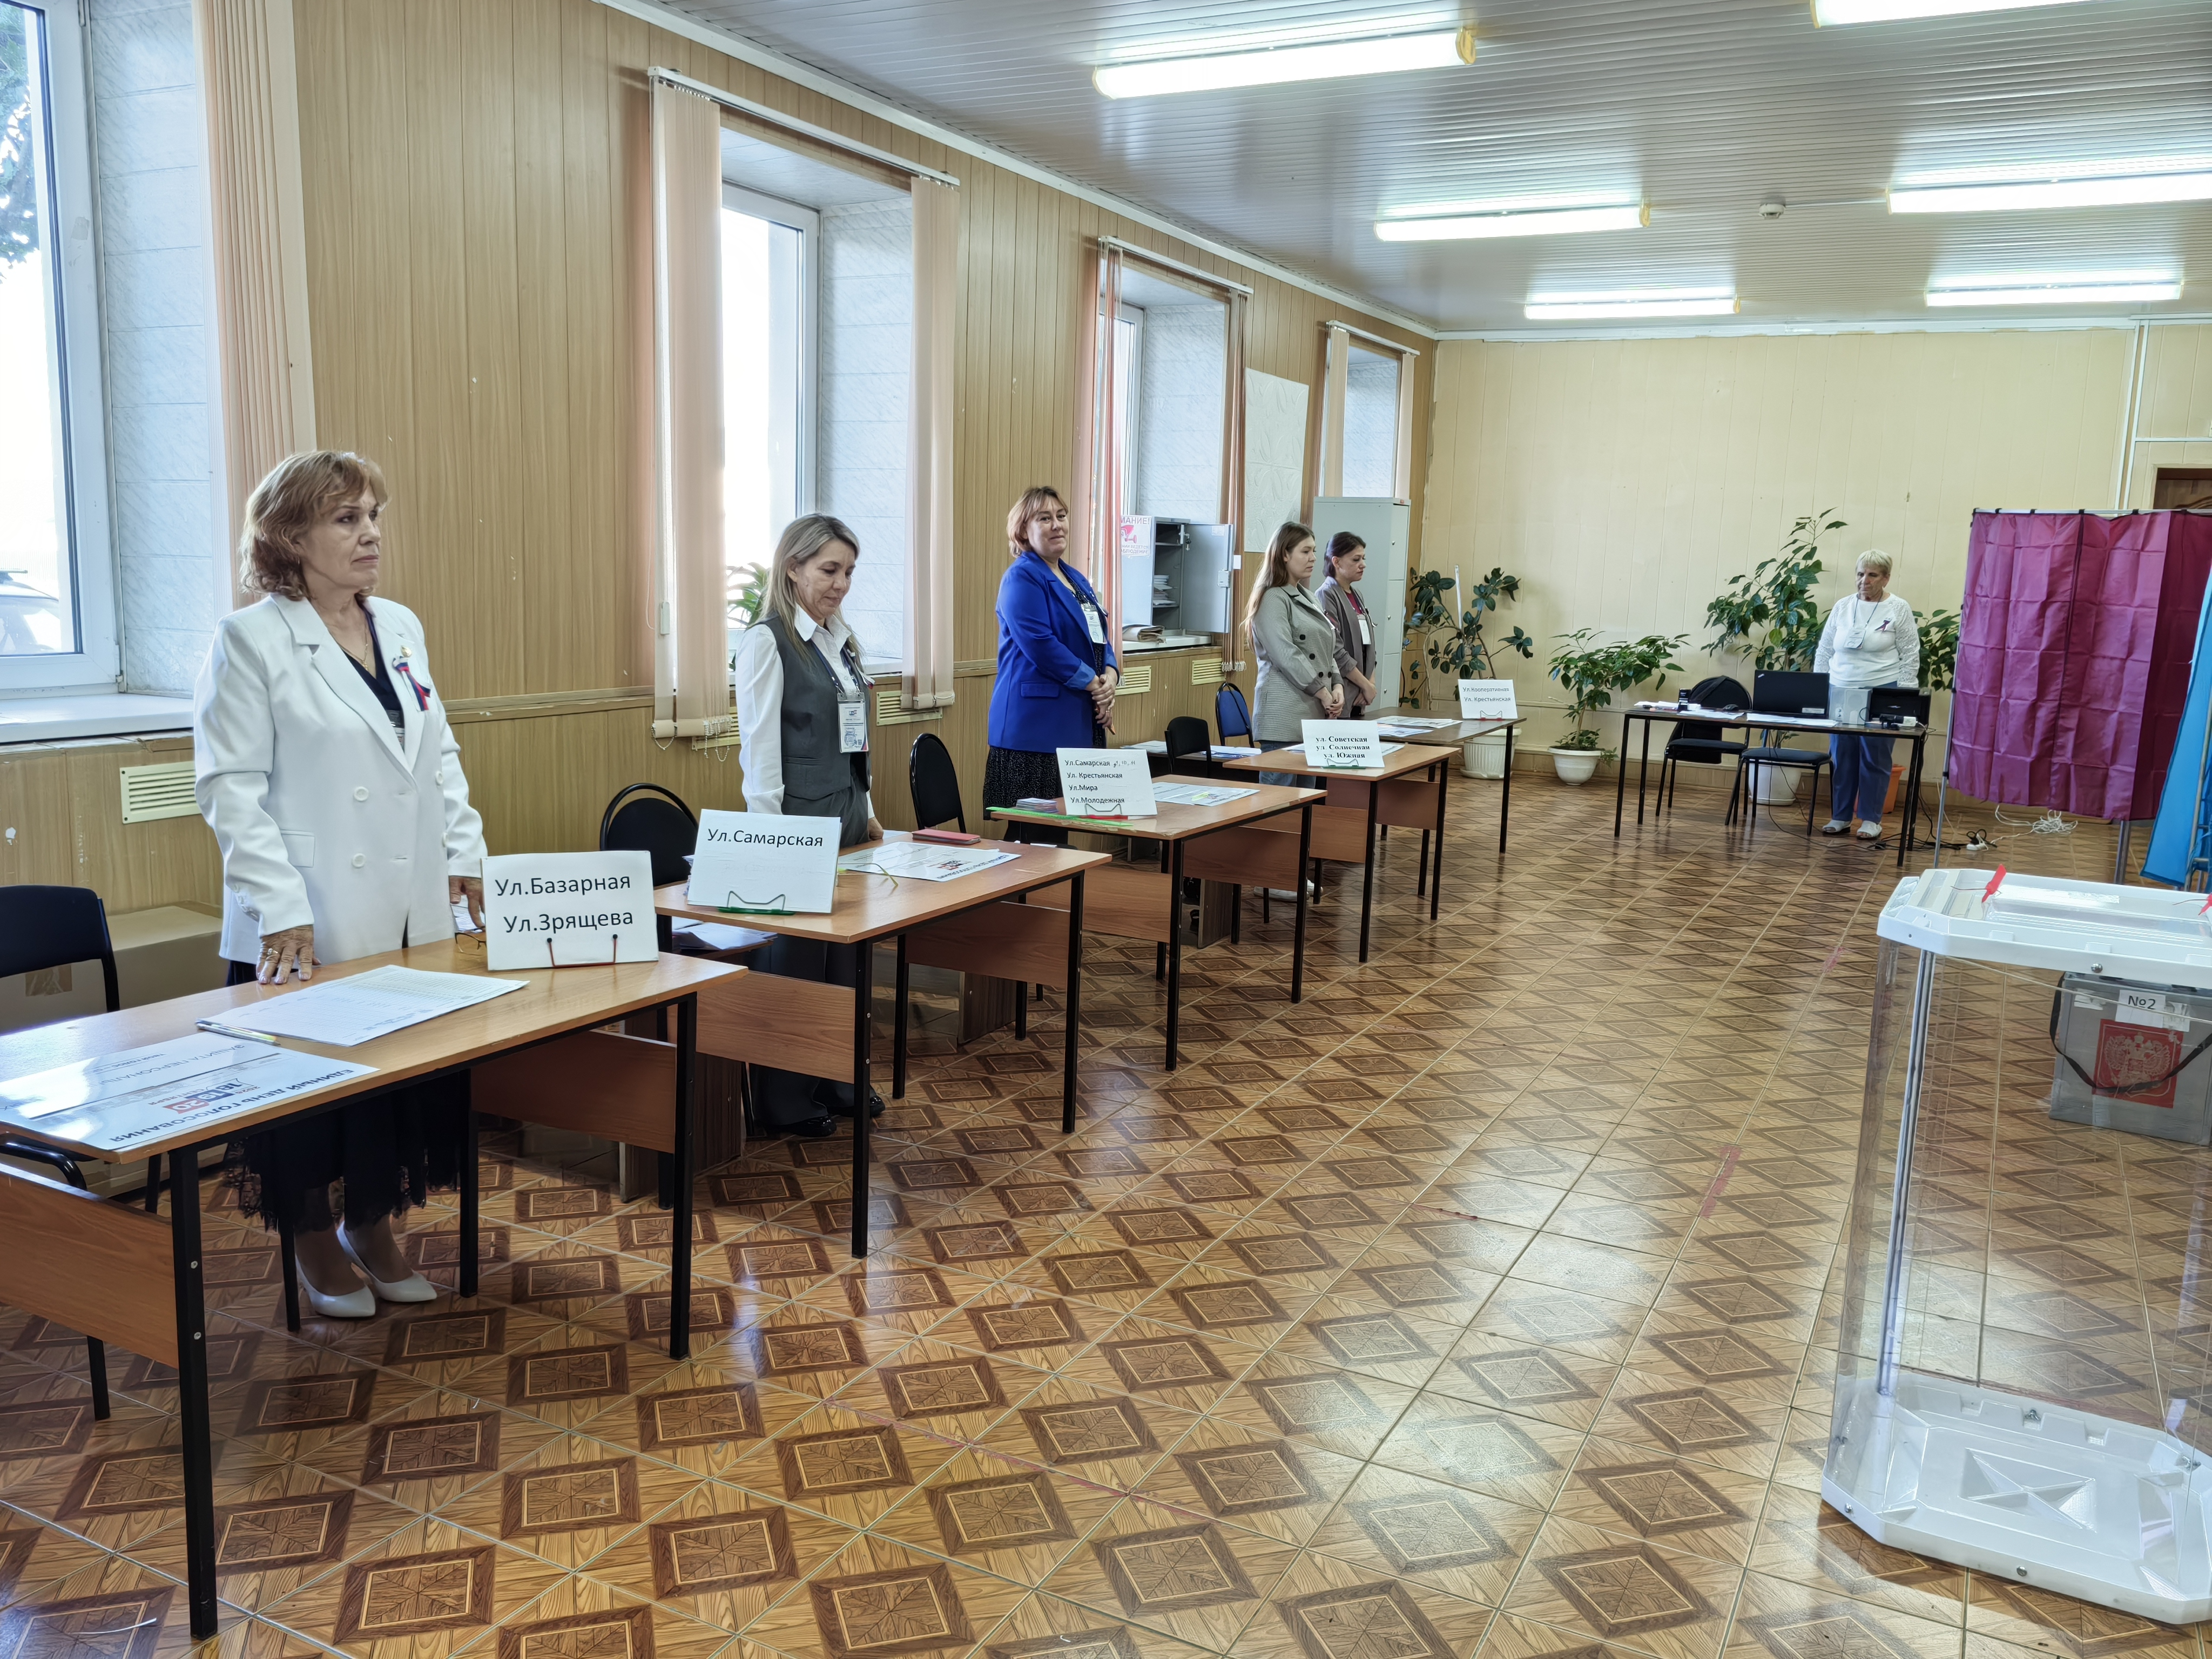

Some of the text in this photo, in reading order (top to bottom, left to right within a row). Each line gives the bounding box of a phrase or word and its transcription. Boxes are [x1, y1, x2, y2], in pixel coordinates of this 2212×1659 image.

[707, 828, 823, 848] Ул.Самарская
[495, 873, 631, 896] Ул.Базарная
[503, 913, 633, 933] Ул.Зрящева
[192, 1044, 245, 1061] ЗАЩИТА
[148, 1088, 205, 1105] СЕНТЯБРЯ
[197, 1090, 224, 1100] 19
[109, 1069, 354, 1142] ЕДИНЫЙ ДЕНЬ ГОЛОСОВАНИЯ
[172, 1100, 206, 1110] 20
